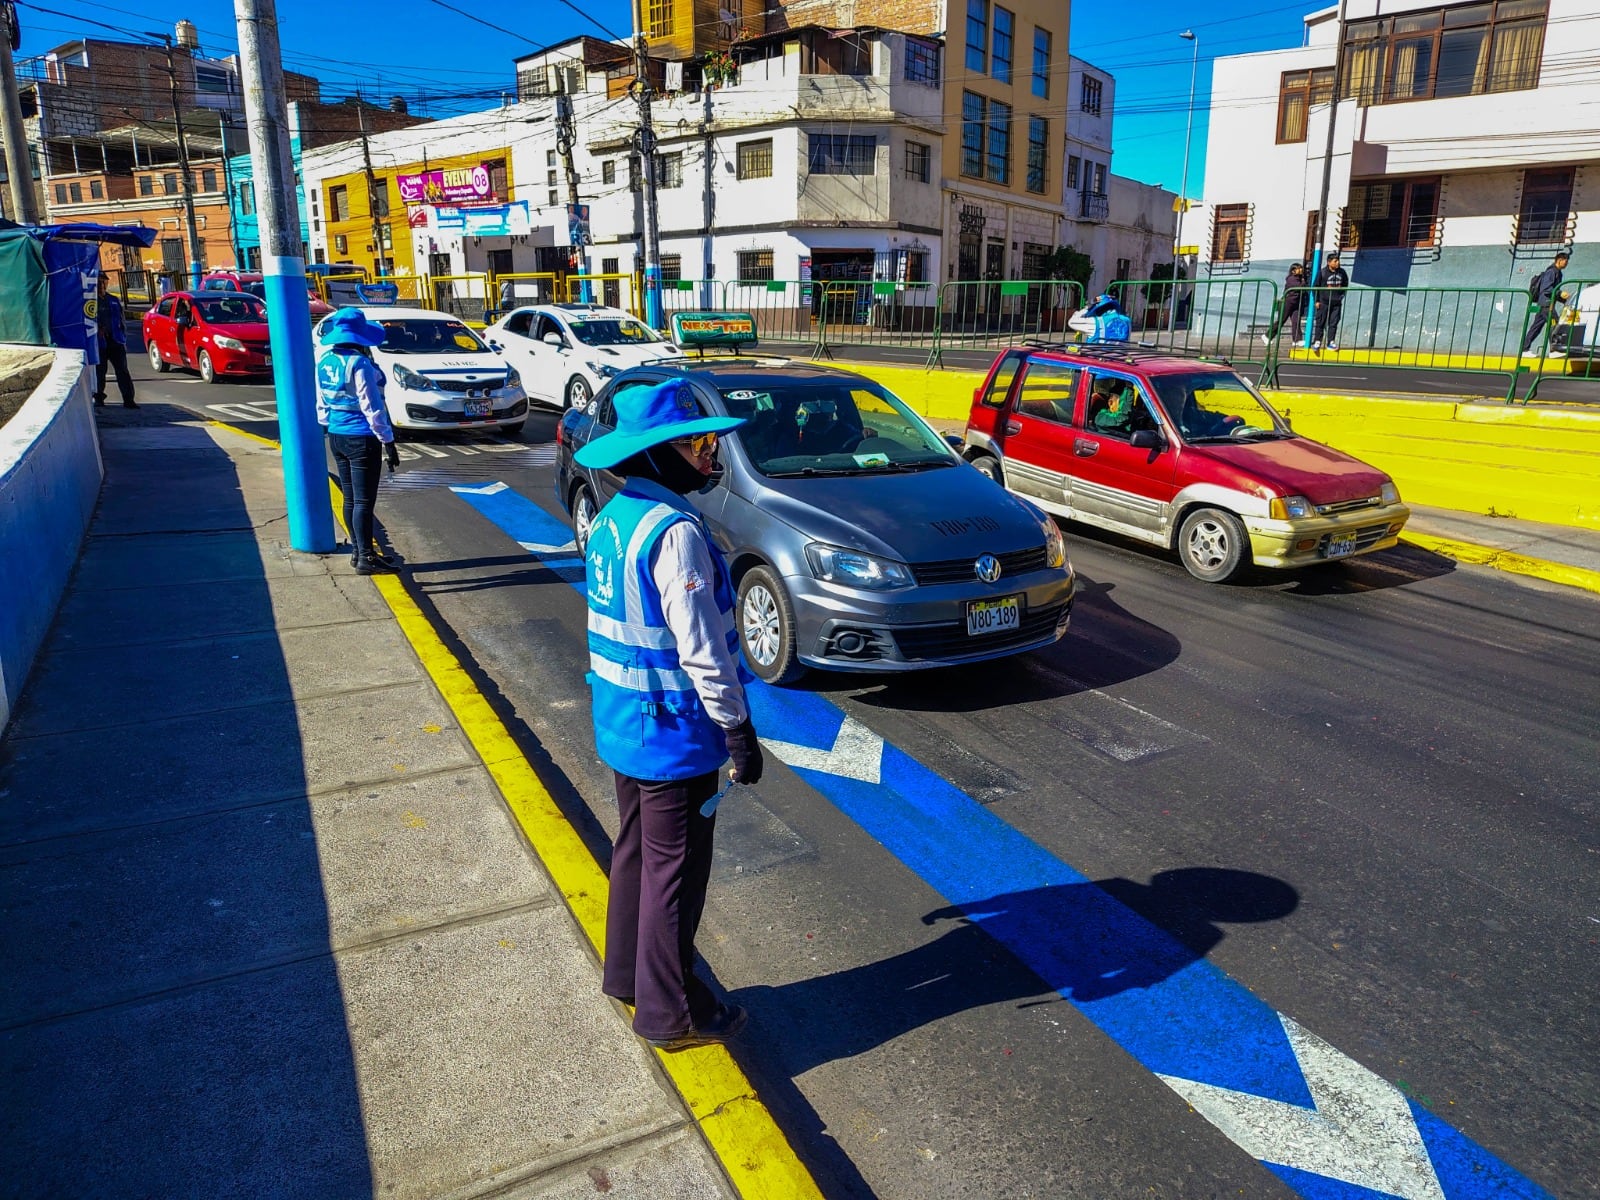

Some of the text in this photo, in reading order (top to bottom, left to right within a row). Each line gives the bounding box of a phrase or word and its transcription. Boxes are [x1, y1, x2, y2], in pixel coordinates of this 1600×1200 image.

[444, 169, 472, 187] EVELYN
[475, 174, 487, 187] 08
[970, 605, 1017, 630] V80-189
